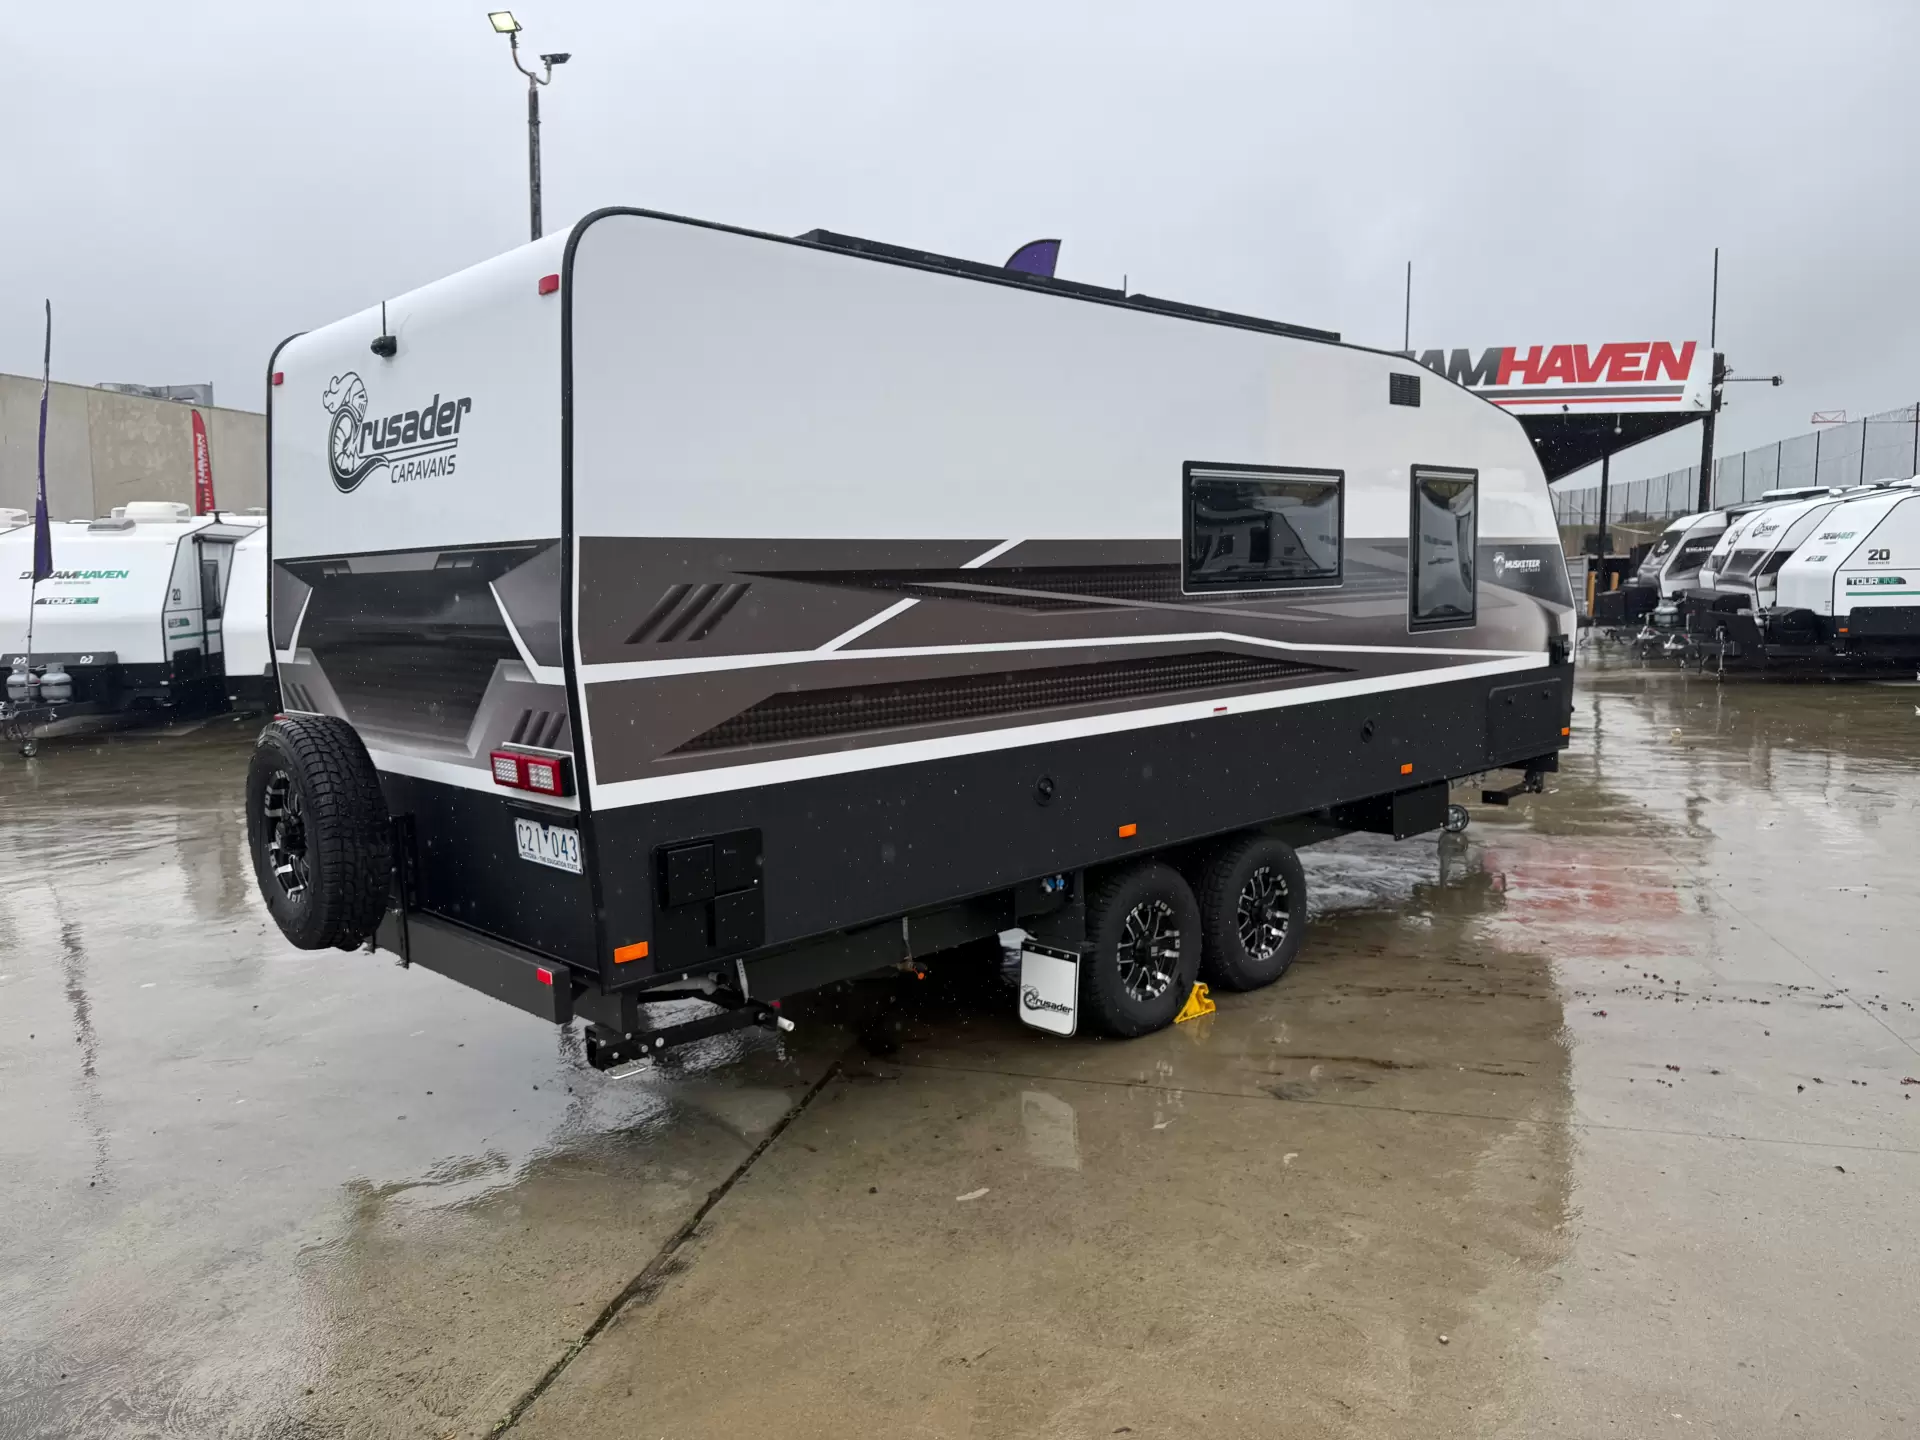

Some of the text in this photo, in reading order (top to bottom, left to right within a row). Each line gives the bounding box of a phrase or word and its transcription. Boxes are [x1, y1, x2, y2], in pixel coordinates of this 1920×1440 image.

[1392, 341, 1697, 386] AMHAVEN
[328, 394, 472, 494] Crusader
[391, 454, 456, 484] CARAVANS
[1867, 548, 1891, 561] 20
[19, 570, 130, 580] DAMHAVEN
[518, 823, 578, 862] C21 043
